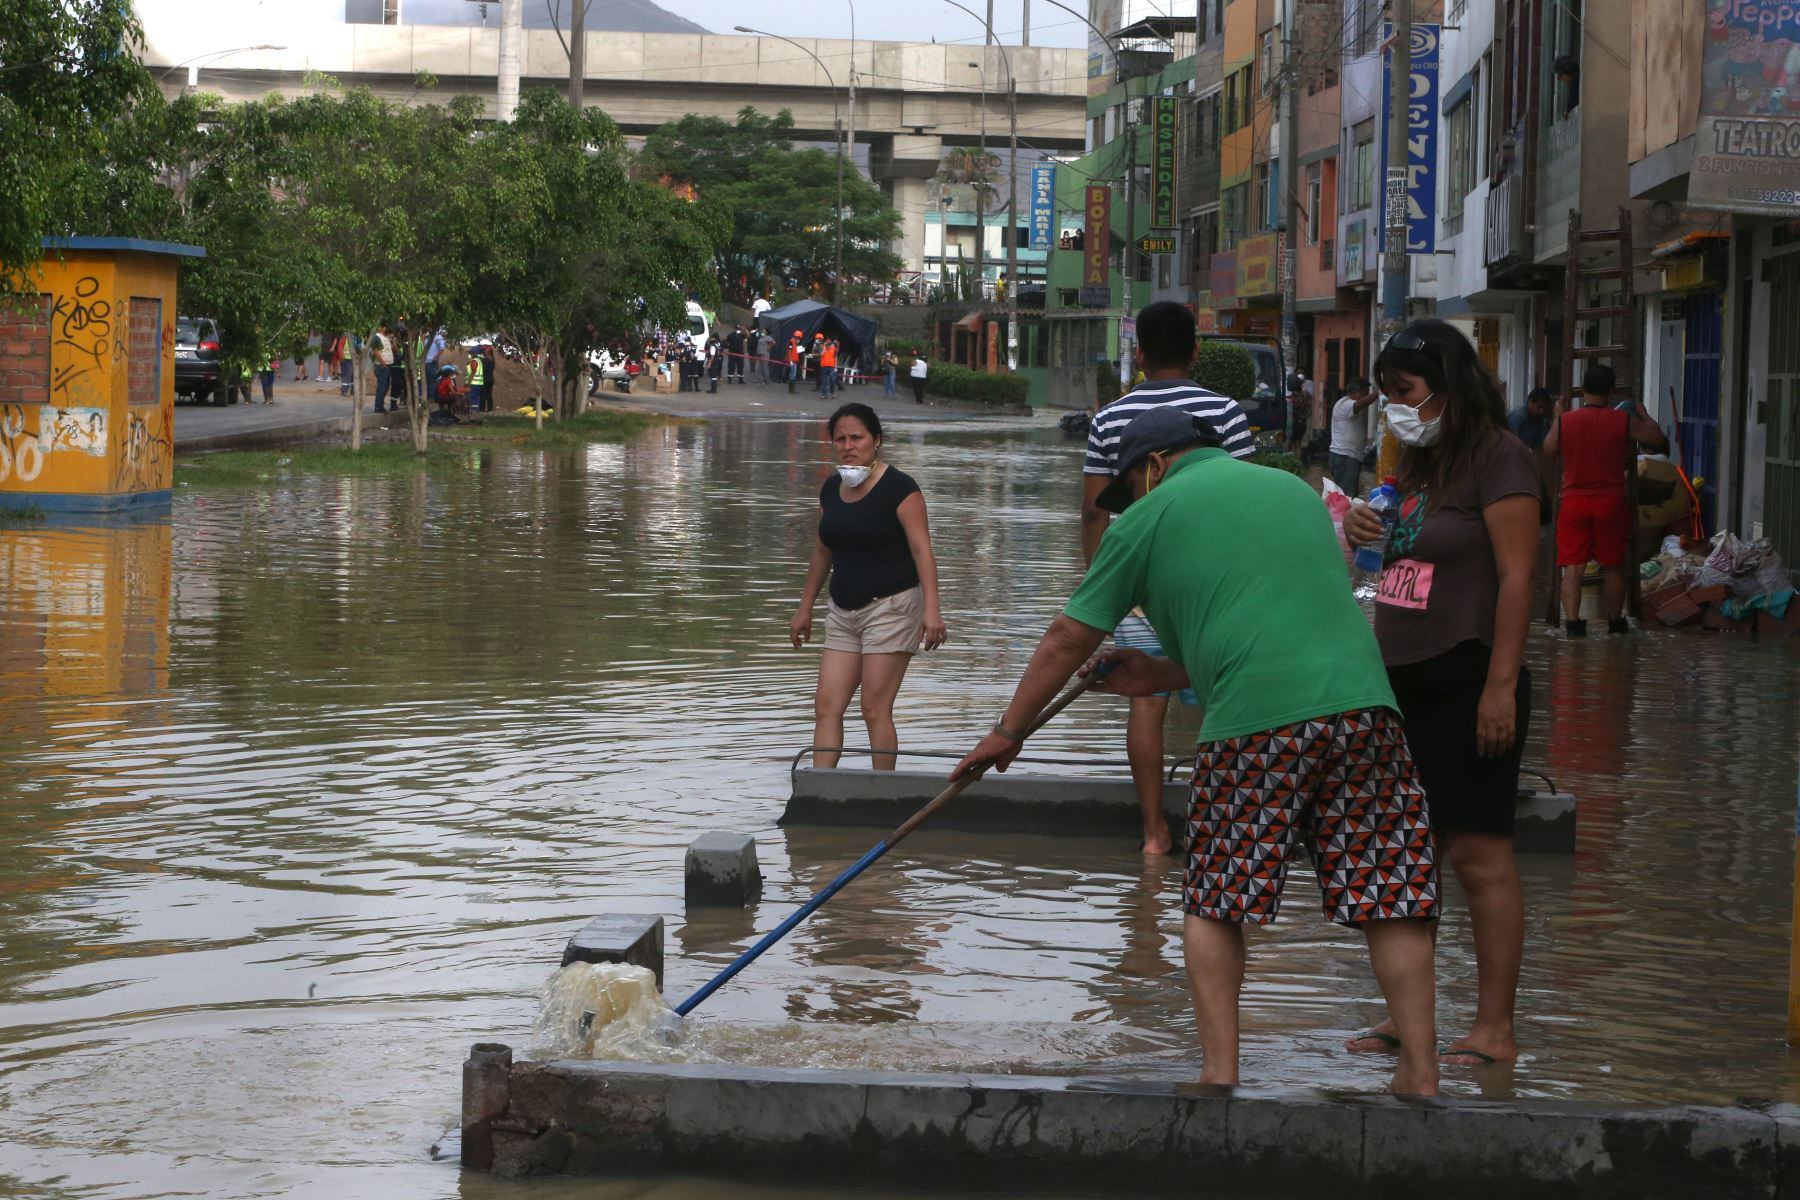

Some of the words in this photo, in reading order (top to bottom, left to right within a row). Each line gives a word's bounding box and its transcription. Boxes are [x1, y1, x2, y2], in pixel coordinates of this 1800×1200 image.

[1713, 119, 1800, 158] TEATRO
[1157, 98, 1174, 227] HOSPEDAJE
[1036, 169, 1051, 205] SANTA
[1034, 208, 1051, 244] MARIA
[1087, 189, 1106, 284] BOTICA
[1143, 240, 1172, 251] EMILY
